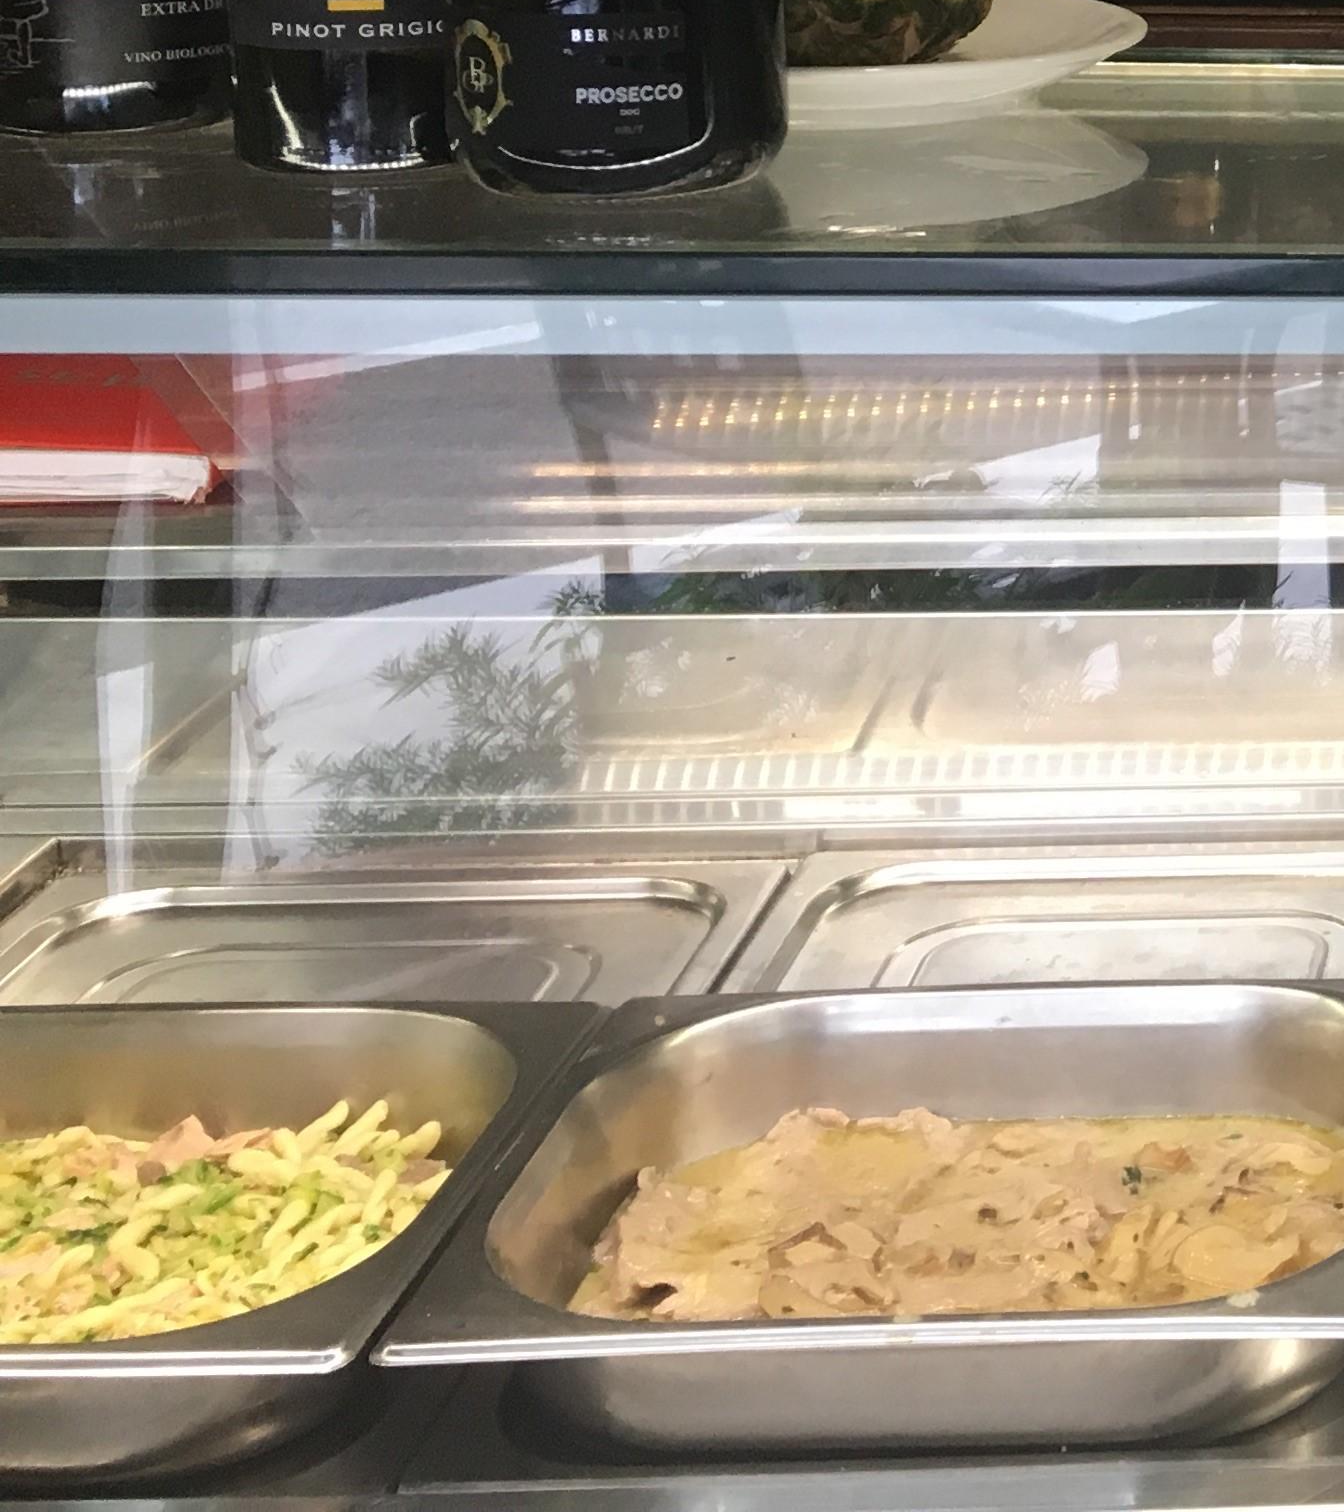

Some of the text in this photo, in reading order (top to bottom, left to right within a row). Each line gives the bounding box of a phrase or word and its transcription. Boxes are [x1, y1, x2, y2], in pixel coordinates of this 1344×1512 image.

[140, 0, 200, 17] EXTRA
[272, 22, 346, 38] PINOT
[570, 25, 681, 42] BERNARDI
[124, 50, 162, 64] VINO
[575, 82, 684, 104] PROSECCO
